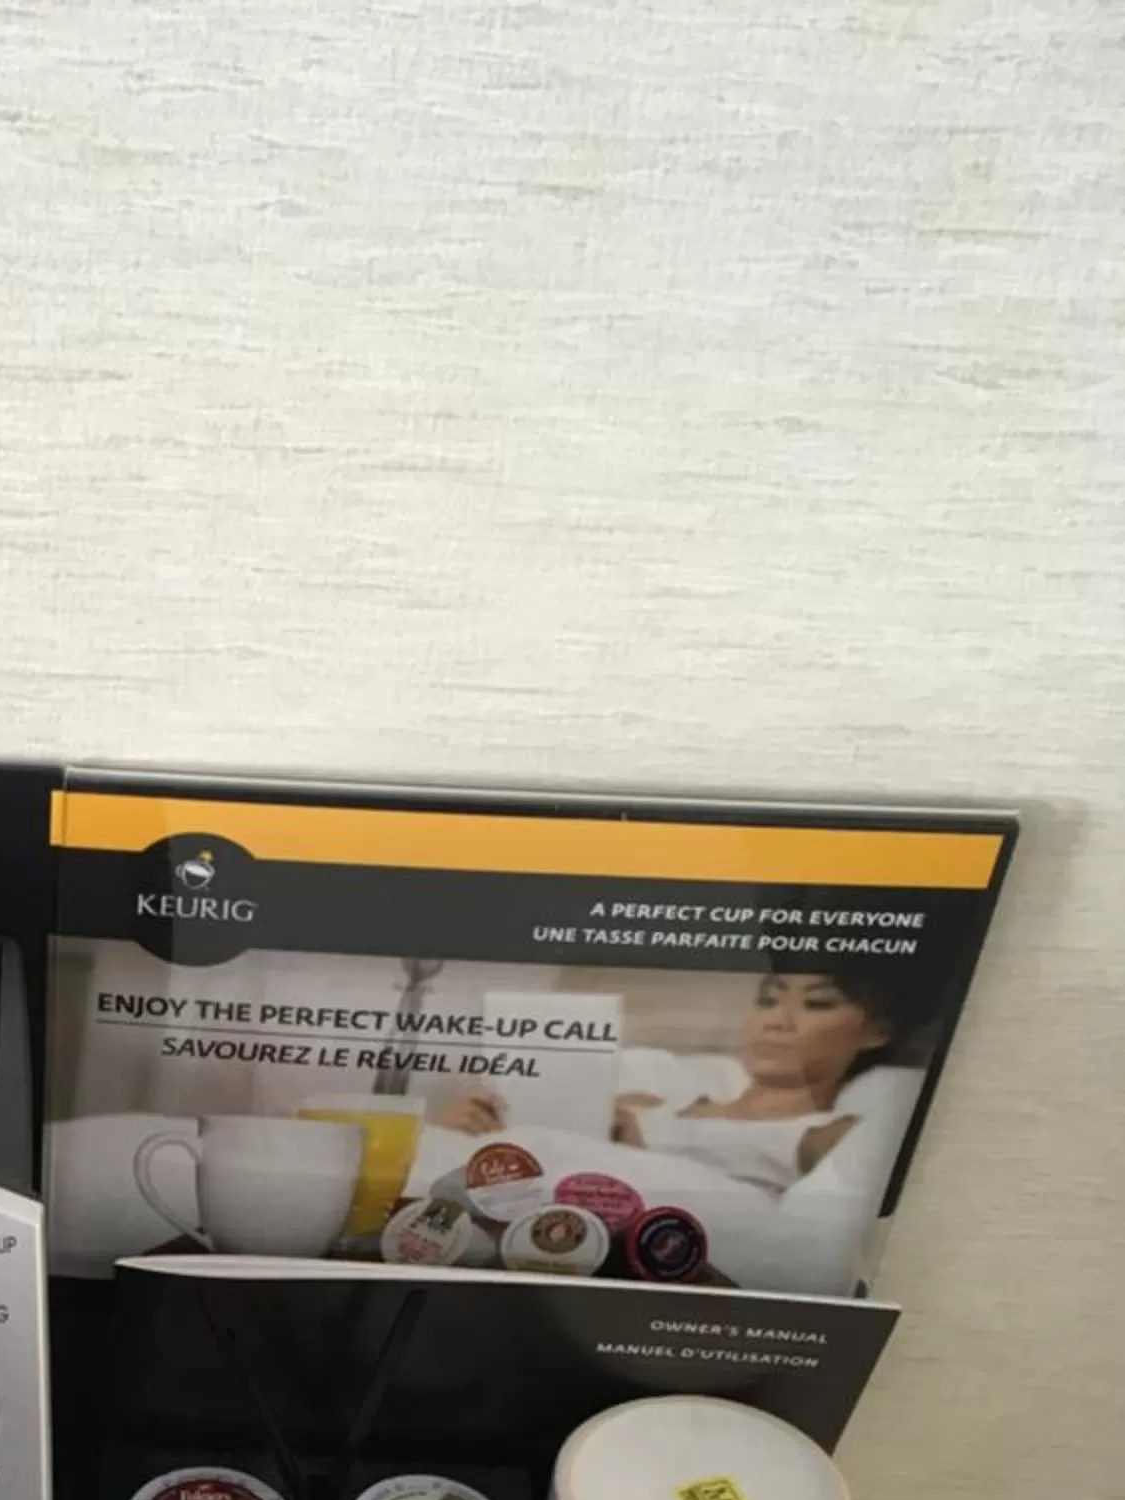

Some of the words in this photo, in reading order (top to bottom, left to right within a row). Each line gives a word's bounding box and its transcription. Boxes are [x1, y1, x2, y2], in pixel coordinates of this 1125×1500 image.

[136, 892, 256, 922] KEURIG
[589, 901, 606, 918] A
[610, 902, 707, 921] PERFECT
[709, 906, 755, 923] CUP
[758, 907, 804, 925] FOR
[808, 909, 925, 929] EVERYONE
[532, 926, 577, 943] UNE
[582, 927, 646, 946] TASSE
[650, 930, 753, 949] PARFAITE
[757, 934, 820, 952] POUR
[824, 937, 917, 955] CHACUN
[97, 992, 186, 1019] ENJOY
[193, 999, 252, 1023] THE
[259, 1003, 389, 1031] PERFECT
[394, 1011, 538, 1039] WAKE-UP
[543, 1019, 618, 1043] CALL
[160, 1036, 311, 1066] SAVOUREZ
[317, 1048, 351, 1069] LE
[355, 1046, 452, 1074] RÉVEIL
[458, 1052, 542, 1078] IDÉAL
[649, 1319, 740, 1338] OWNER'S
[745, 1327, 828, 1345] MANUAL
[595, 1342, 676, 1358] MANUEL
[679, 1346, 820, 1368] D'UTILISATION
